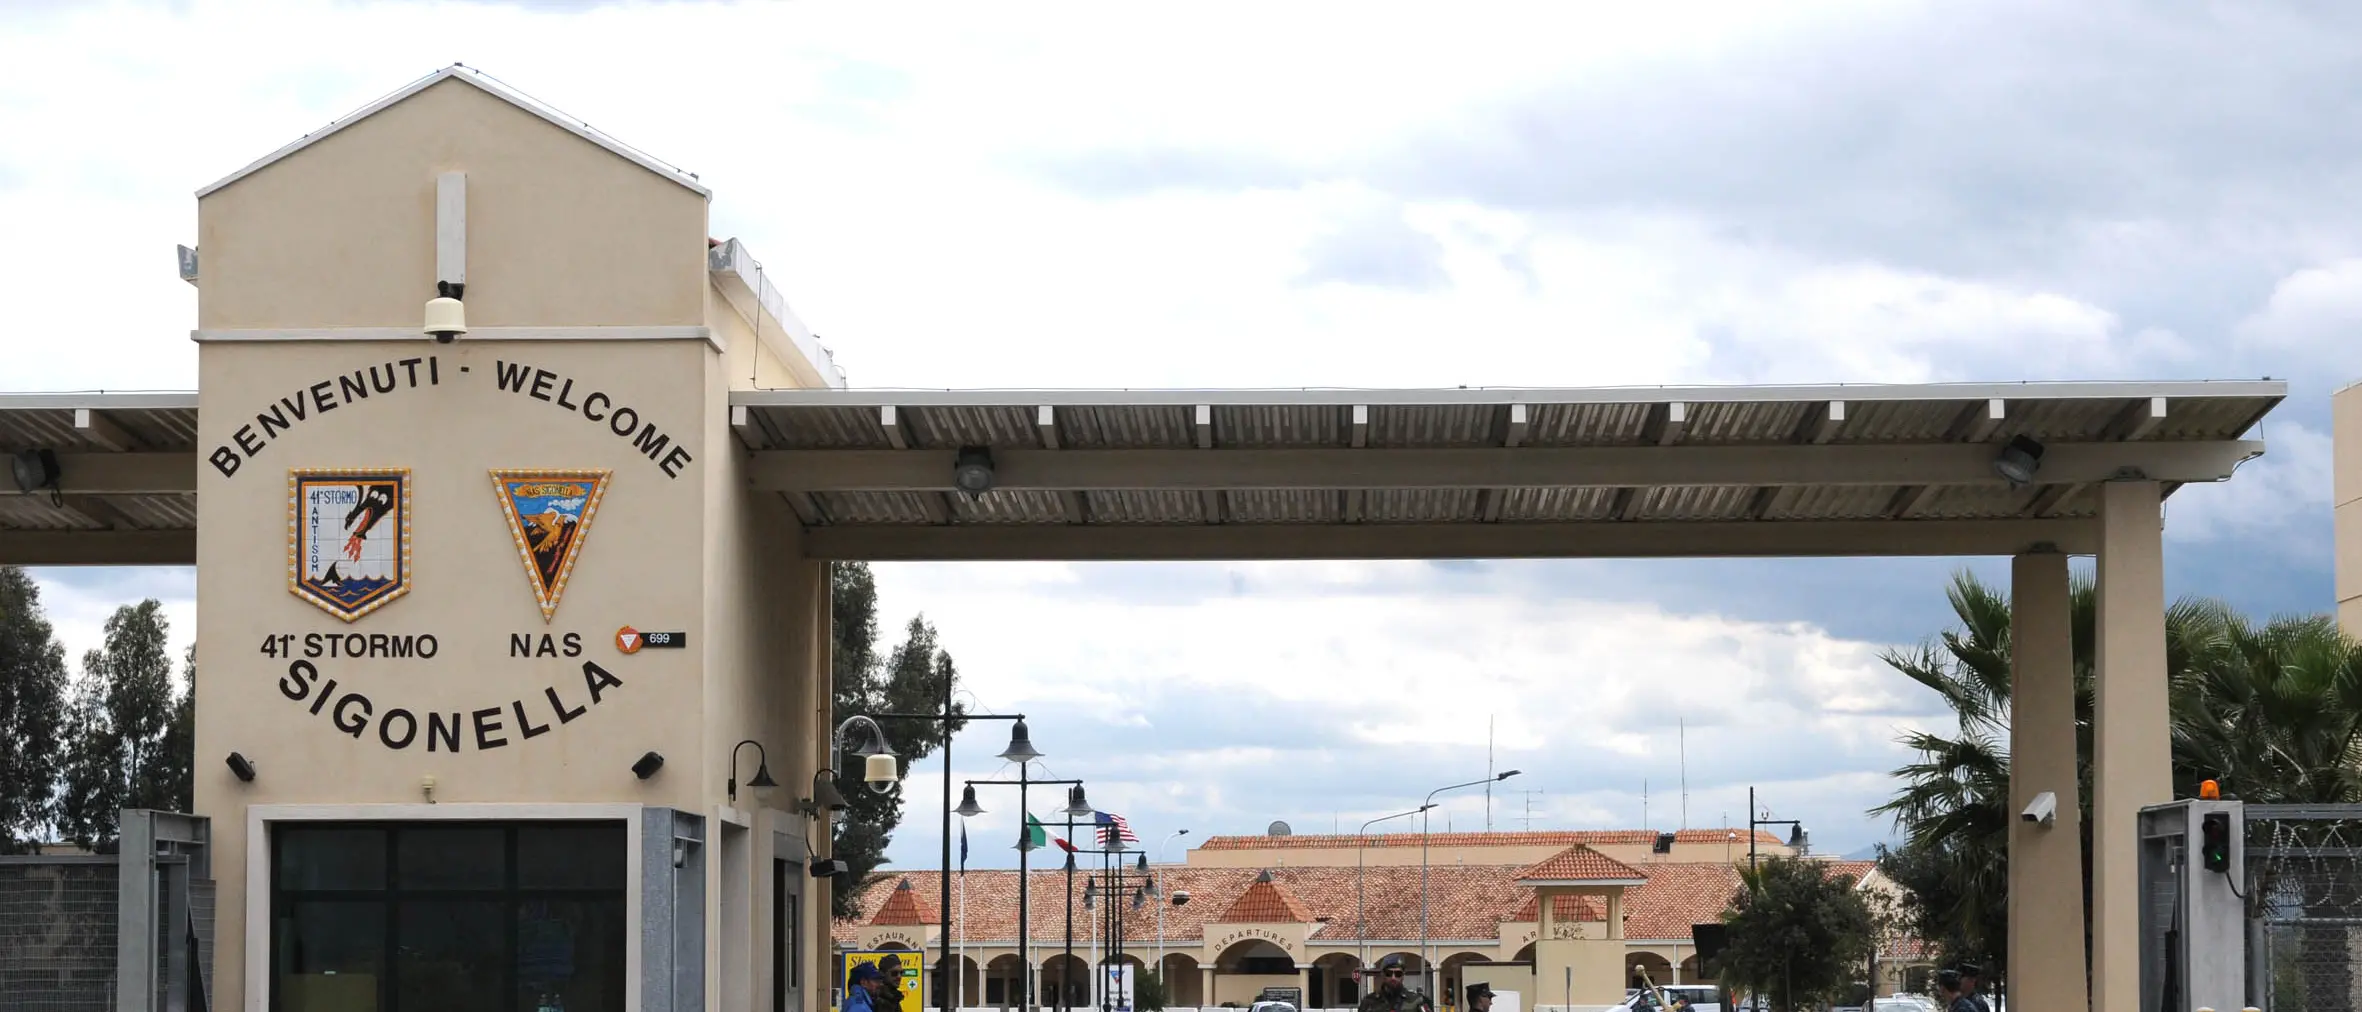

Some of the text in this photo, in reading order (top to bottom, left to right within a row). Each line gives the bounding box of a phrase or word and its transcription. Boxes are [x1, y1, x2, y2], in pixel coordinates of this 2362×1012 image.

[208, 355, 439, 478] BENVENUTI
[496, 360, 692, 480] WELCOME
[325, 490, 357, 505] STORMO
[311, 506, 319, 572] ANTISOM
[303, 633, 438, 659] STORMO
[510, 633, 582, 658] NAS
[649, 633, 670, 644] 699
[278, 659, 623, 753] SIGONELLA
[866, 931, 922, 949] ESTAURAN
[1214, 928, 1294, 952] DEPARTURES
